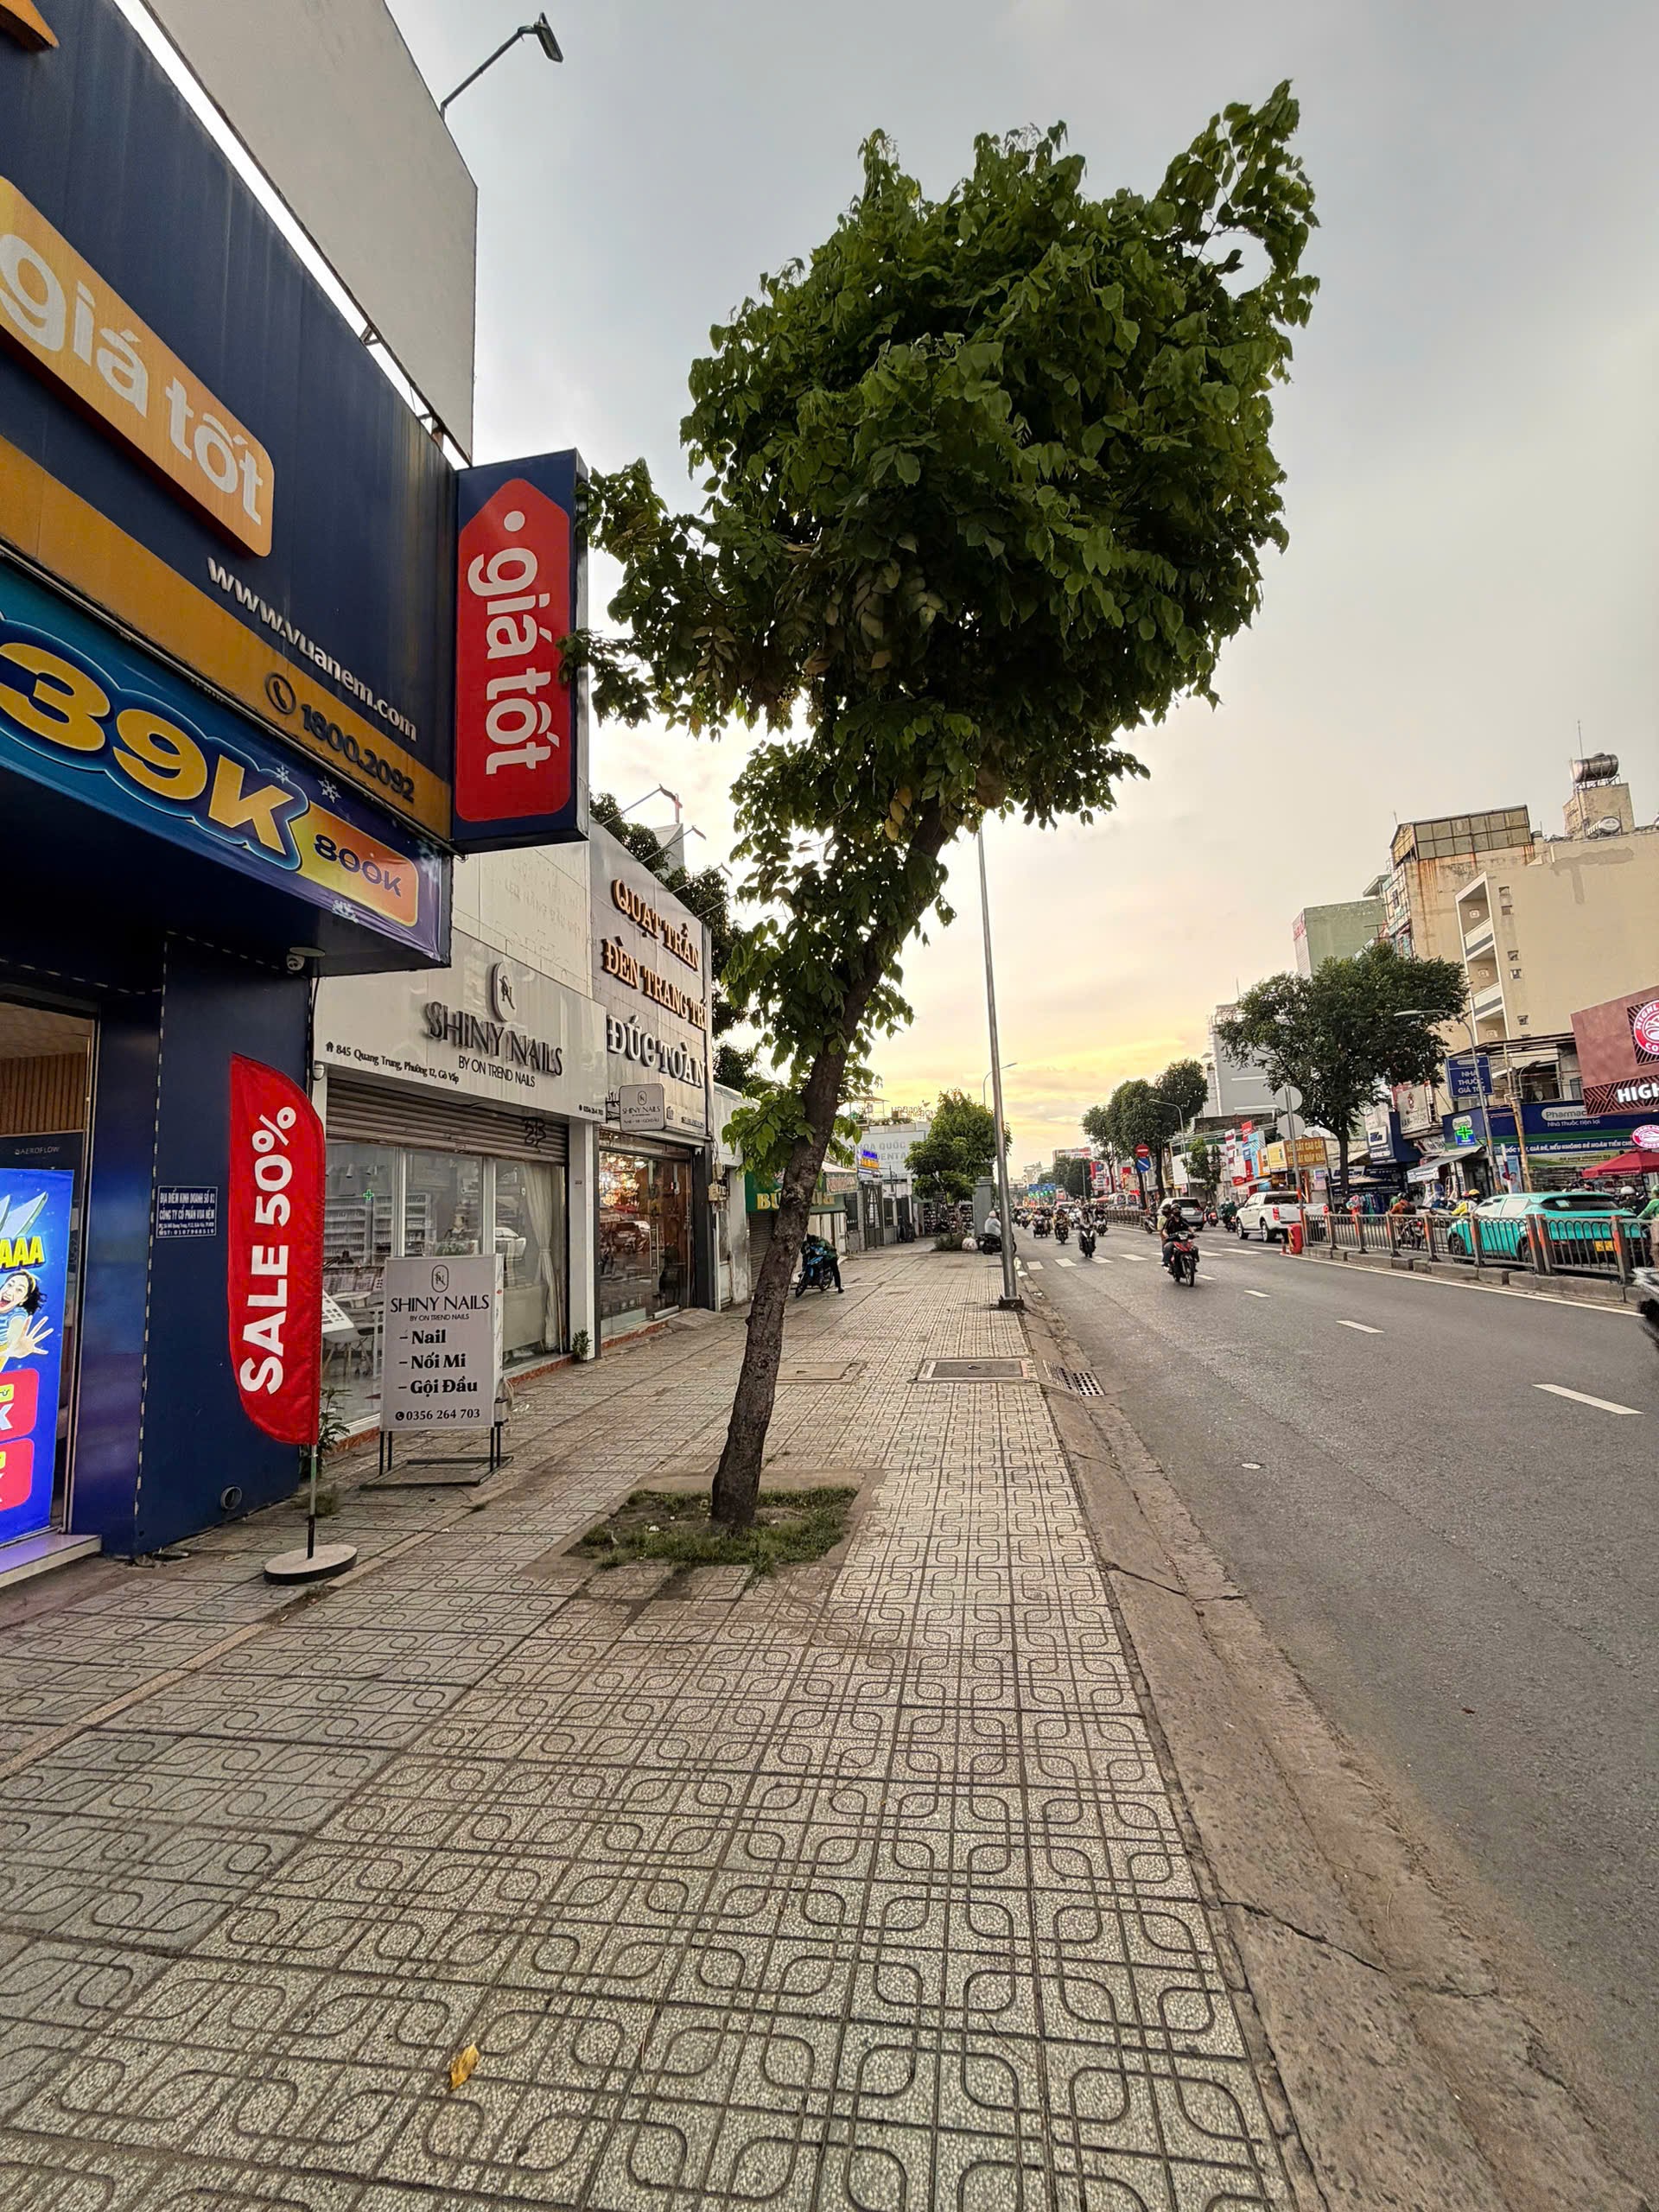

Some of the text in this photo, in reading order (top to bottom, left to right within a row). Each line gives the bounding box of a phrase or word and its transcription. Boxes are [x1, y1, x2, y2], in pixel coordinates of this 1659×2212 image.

[0, 232, 263, 525] giá tốt
[207, 556, 417, 742] www.vuanem.com
[467, 547, 560, 775] giá tốt
[0, 642, 294, 857] 39K
[301, 703, 415, 804] 1800.2092
[314, 834, 403, 898] 800K
[611, 878, 661, 939] QUẠT
[663, 923, 699, 971] TRẦN
[601, 936, 708, 1031] ĐÈN TRANG TRÍ
[336, 1044, 352, 1057] 845
[353, 1049, 379, 1066] Quang
[381, 1055, 403, 1071] Trung,
[425, 1001, 563, 1077] SHINY NAILS
[459, 1055, 536, 1088] BY ON TREND NAILS
[607, 1014, 706, 1089] ĐỨC TOÀN
[1545, 1109, 1586, 1119] Pharmac
[239, 1106, 296, 1395] SALE 50%
[391, 1294, 490, 1313] SHINY NAILS
[411, 1329, 446, 1344] Nail
[410, 1351, 467, 1369] Nối Mi
[410, 1376, 478, 1398] Gội Đầu
[406, 1408, 480, 1421] 0356 264 703
